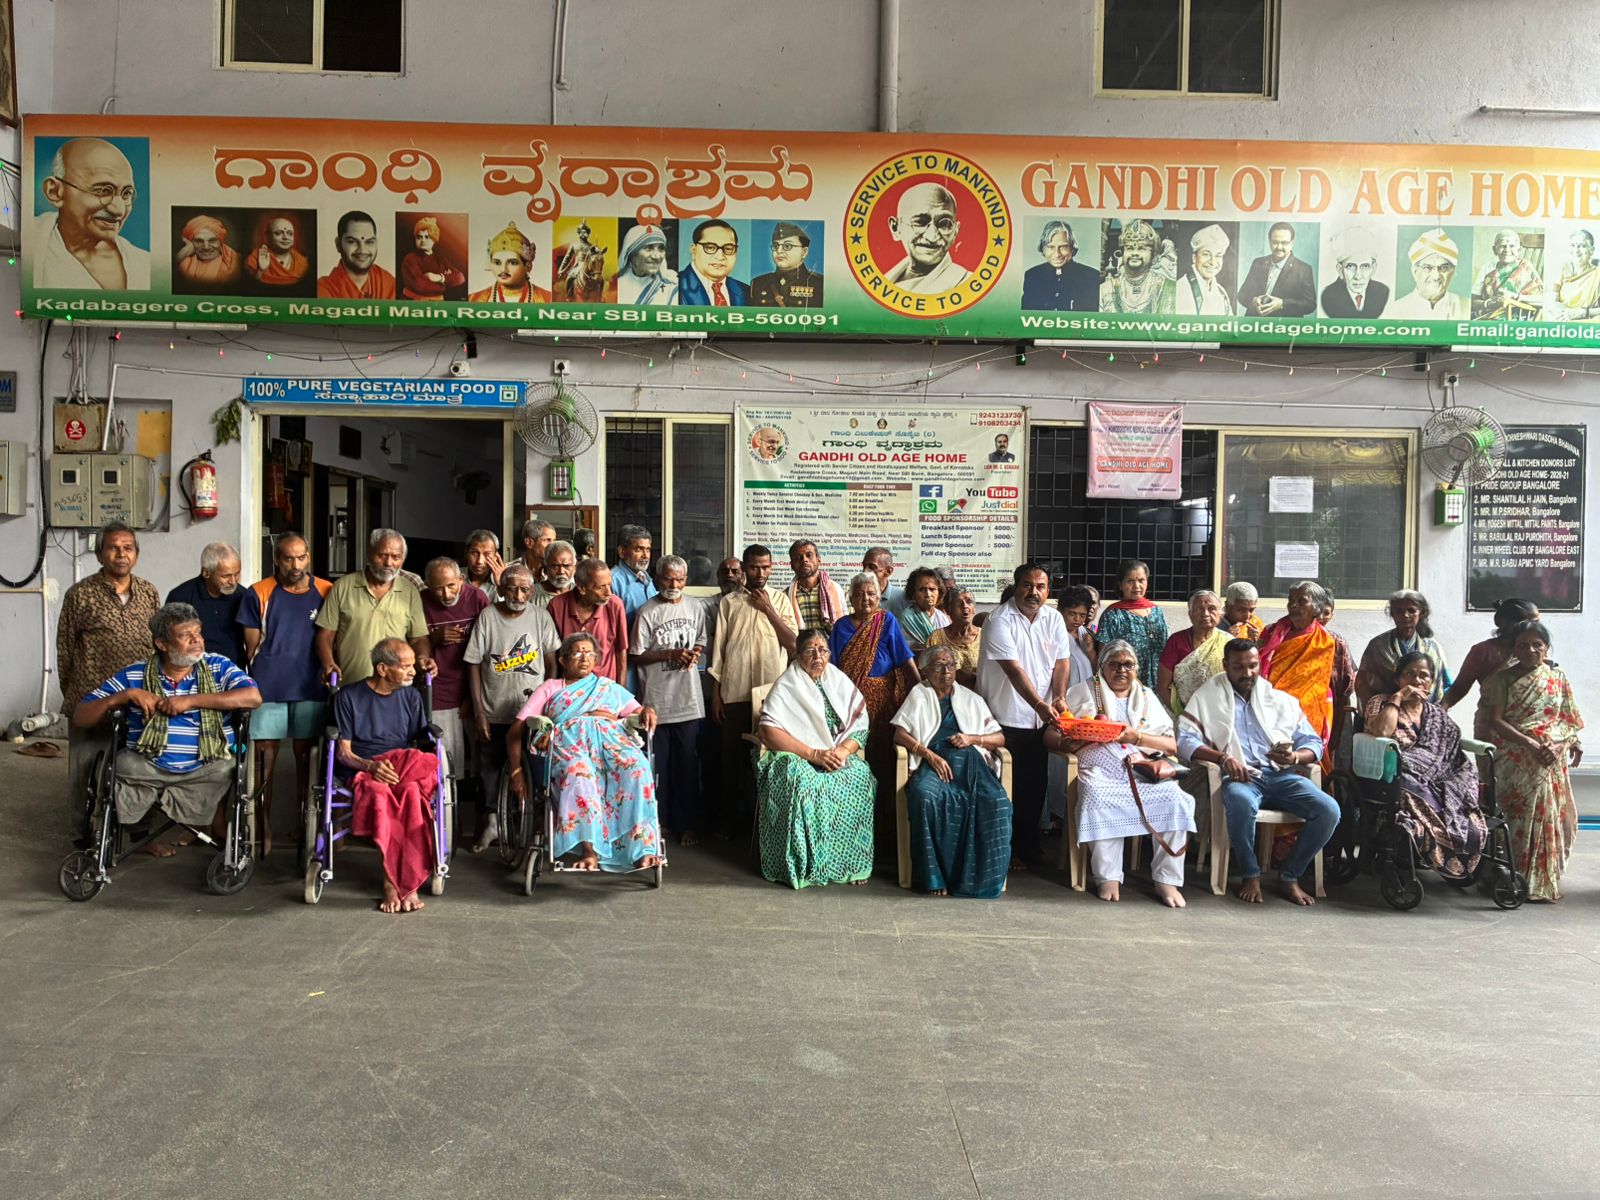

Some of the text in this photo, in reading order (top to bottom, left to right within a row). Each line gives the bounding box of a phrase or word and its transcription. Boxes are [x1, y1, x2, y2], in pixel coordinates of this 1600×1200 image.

[850, 155, 1006, 229] SERVICE TO MANKIND
[1020, 160, 1600, 221] GANDHI OLD AGE HOME
[854, 252, 1000, 311] SERVICE TO GOD
[36, 299, 188, 313] Kadabagere
[197, 302, 279, 316] Cross,
[289, 304, 380, 318] Magadi
[389, 307, 448, 318] Main
[457, 308, 529, 321] Road,
[538, 309, 596, 320] Near
[604, 310, 647, 322] SBI
[249, 380, 496, 397] 100% PURE VEGETARIAN FOOD
[799, 452, 967, 463] GANDHI OLD AGE HOME
[1517, 459, 1540, 467] KITCHEN
[1541, 459, 1563, 467] DONORS
[1564, 459, 1576, 467] LIST
[981, 500, 1019, 509] Justdial
[1549, 496, 1577, 505] Bangalore
[1532, 508, 1560, 517] Bangalore
[1558, 520, 1580, 530] Bangalore
[1554, 533, 1578, 543] Bangalore
[1513, 546, 1526, 554] CLUB
[1527, 546, 1534, 554] OF
[1535, 546, 1566, 554] BANGALORE
[1567, 546, 1580, 554] EAST
[1535, 559, 1549, 567] YARD
[1550, 559, 1575, 569] Bangalore
[495, 650, 538, 673] SUZUKI
